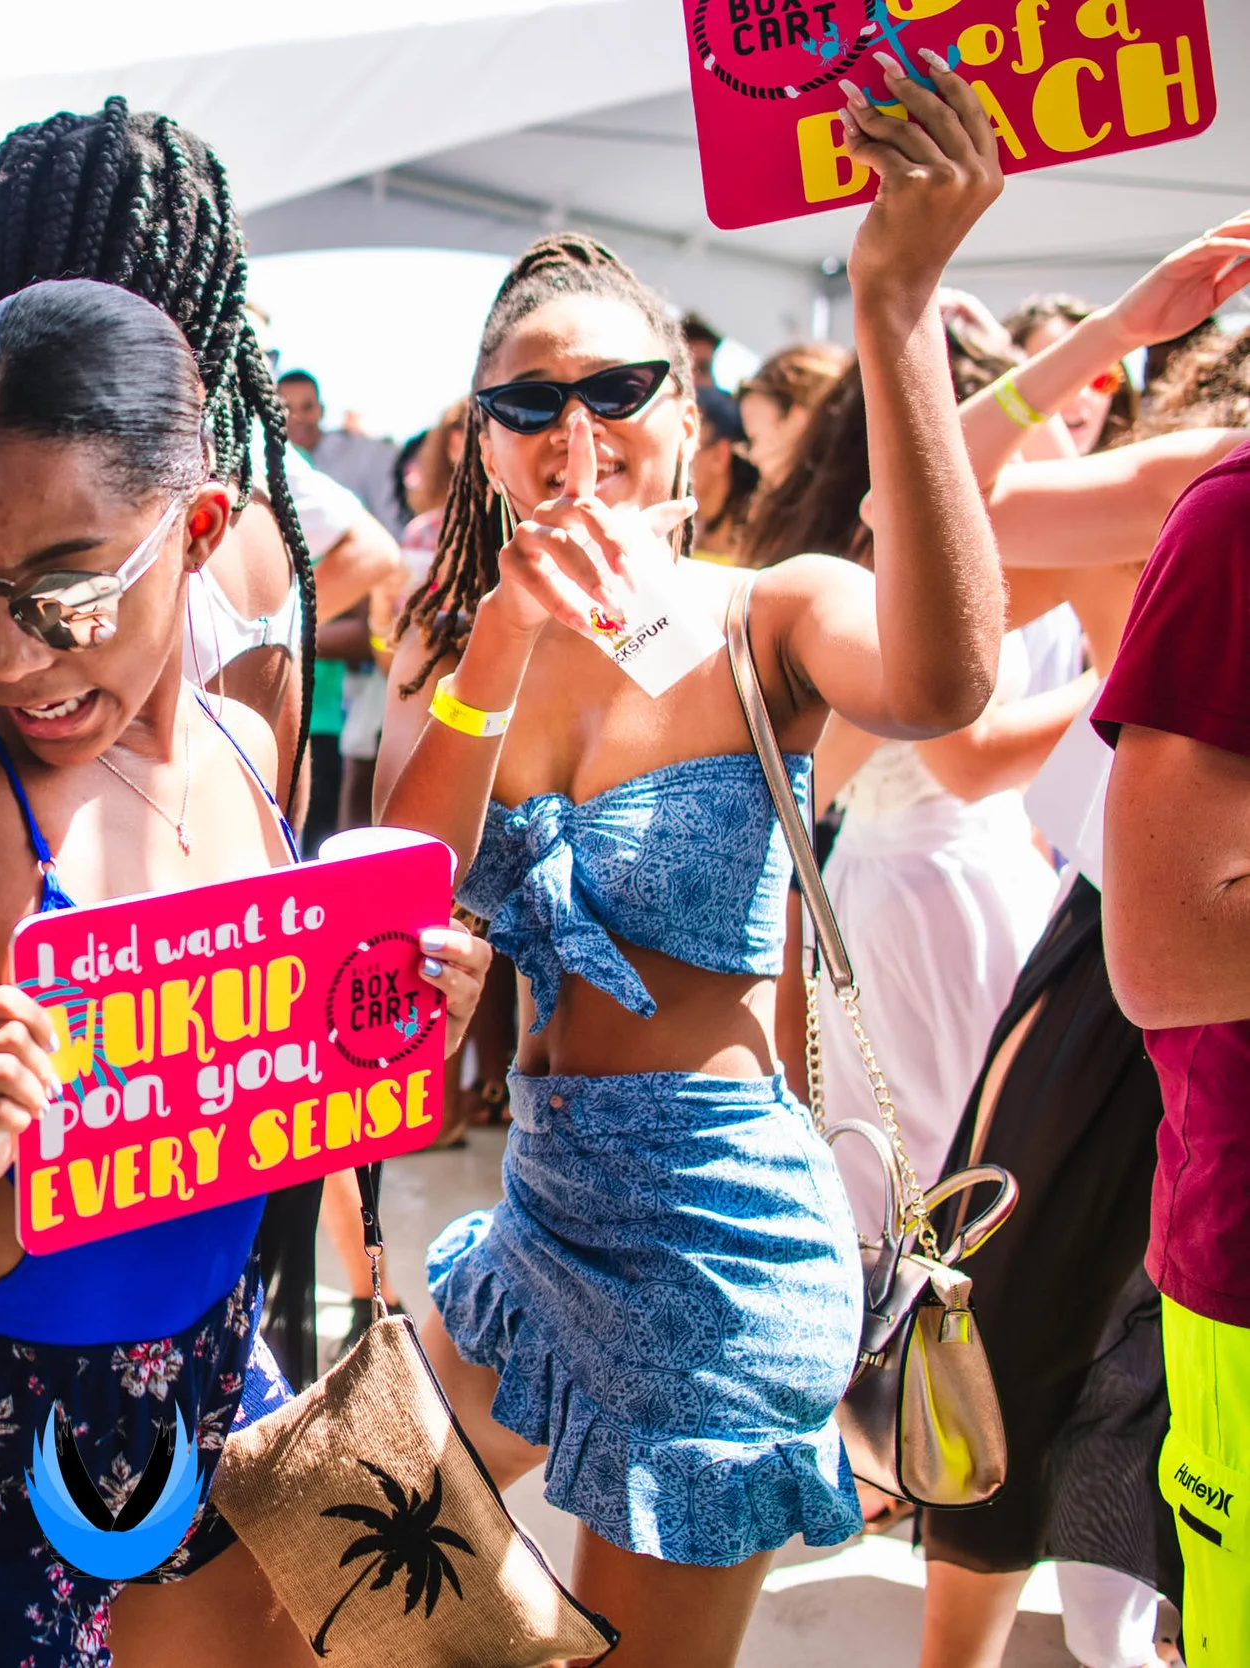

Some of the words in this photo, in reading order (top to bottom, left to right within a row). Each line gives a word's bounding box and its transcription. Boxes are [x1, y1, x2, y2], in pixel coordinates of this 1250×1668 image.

[732, 2, 836, 56] CART
[957, 0, 1049, 74] of
[1075, 0, 1141, 41] a
[797, 35, 1199, 203] BACH
[37, 943, 55, 988] I
[71, 923, 142, 983] did
[154, 904, 266, 964] want
[280, 896, 325, 935] to
[48, 955, 306, 1085] WUKUP
[351, 968, 400, 1004] BOX
[351, 990, 420, 1032] CART
[39, 1075, 171, 1160] pon
[197, 1040, 323, 1116] you
[30, 1123, 226, 1232] EVERY
[248, 1069, 433, 1171] SENSE
[1173, 1462, 1219, 1506] Hurley
